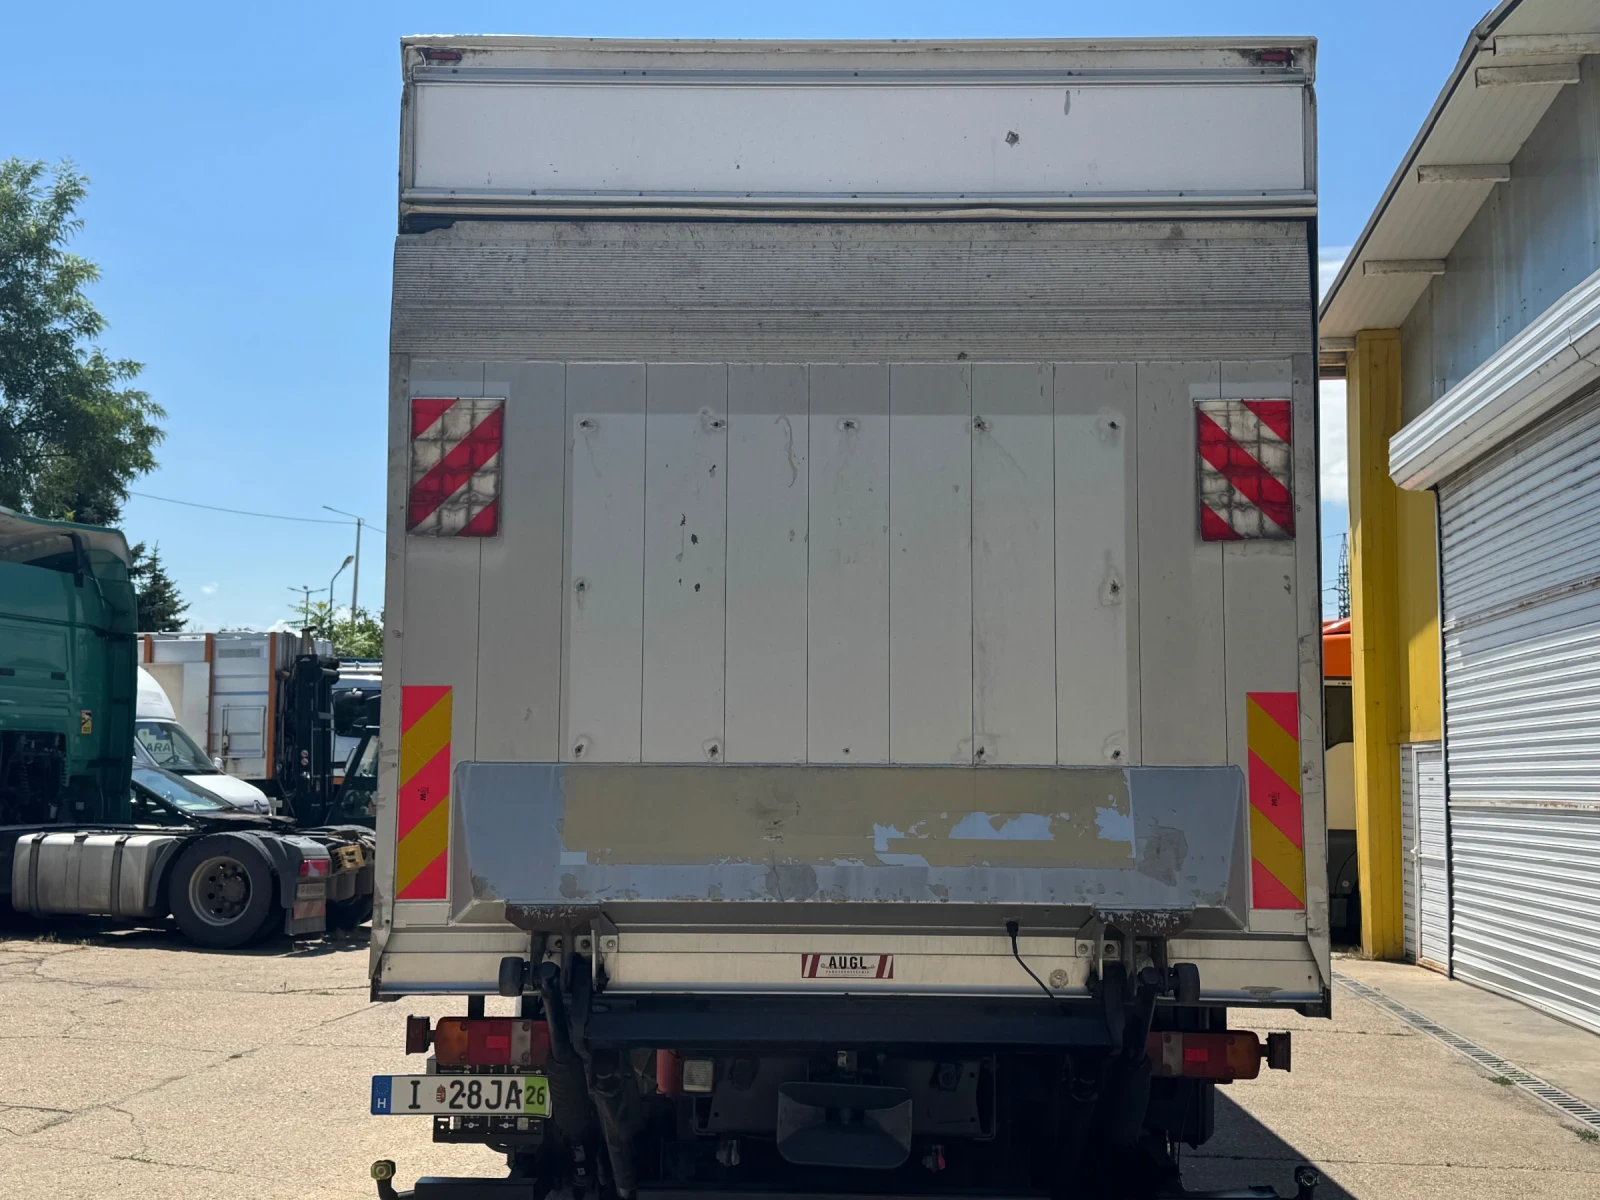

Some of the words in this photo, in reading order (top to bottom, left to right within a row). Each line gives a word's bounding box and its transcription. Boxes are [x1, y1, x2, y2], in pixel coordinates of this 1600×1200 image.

[829, 956, 867, 969] AUGL
[408, 1080, 421, 1110] I
[449, 1079, 522, 1110] 28JA
[525, 1085, 546, 1106] 26
[377, 1098, 386, 1109] H
